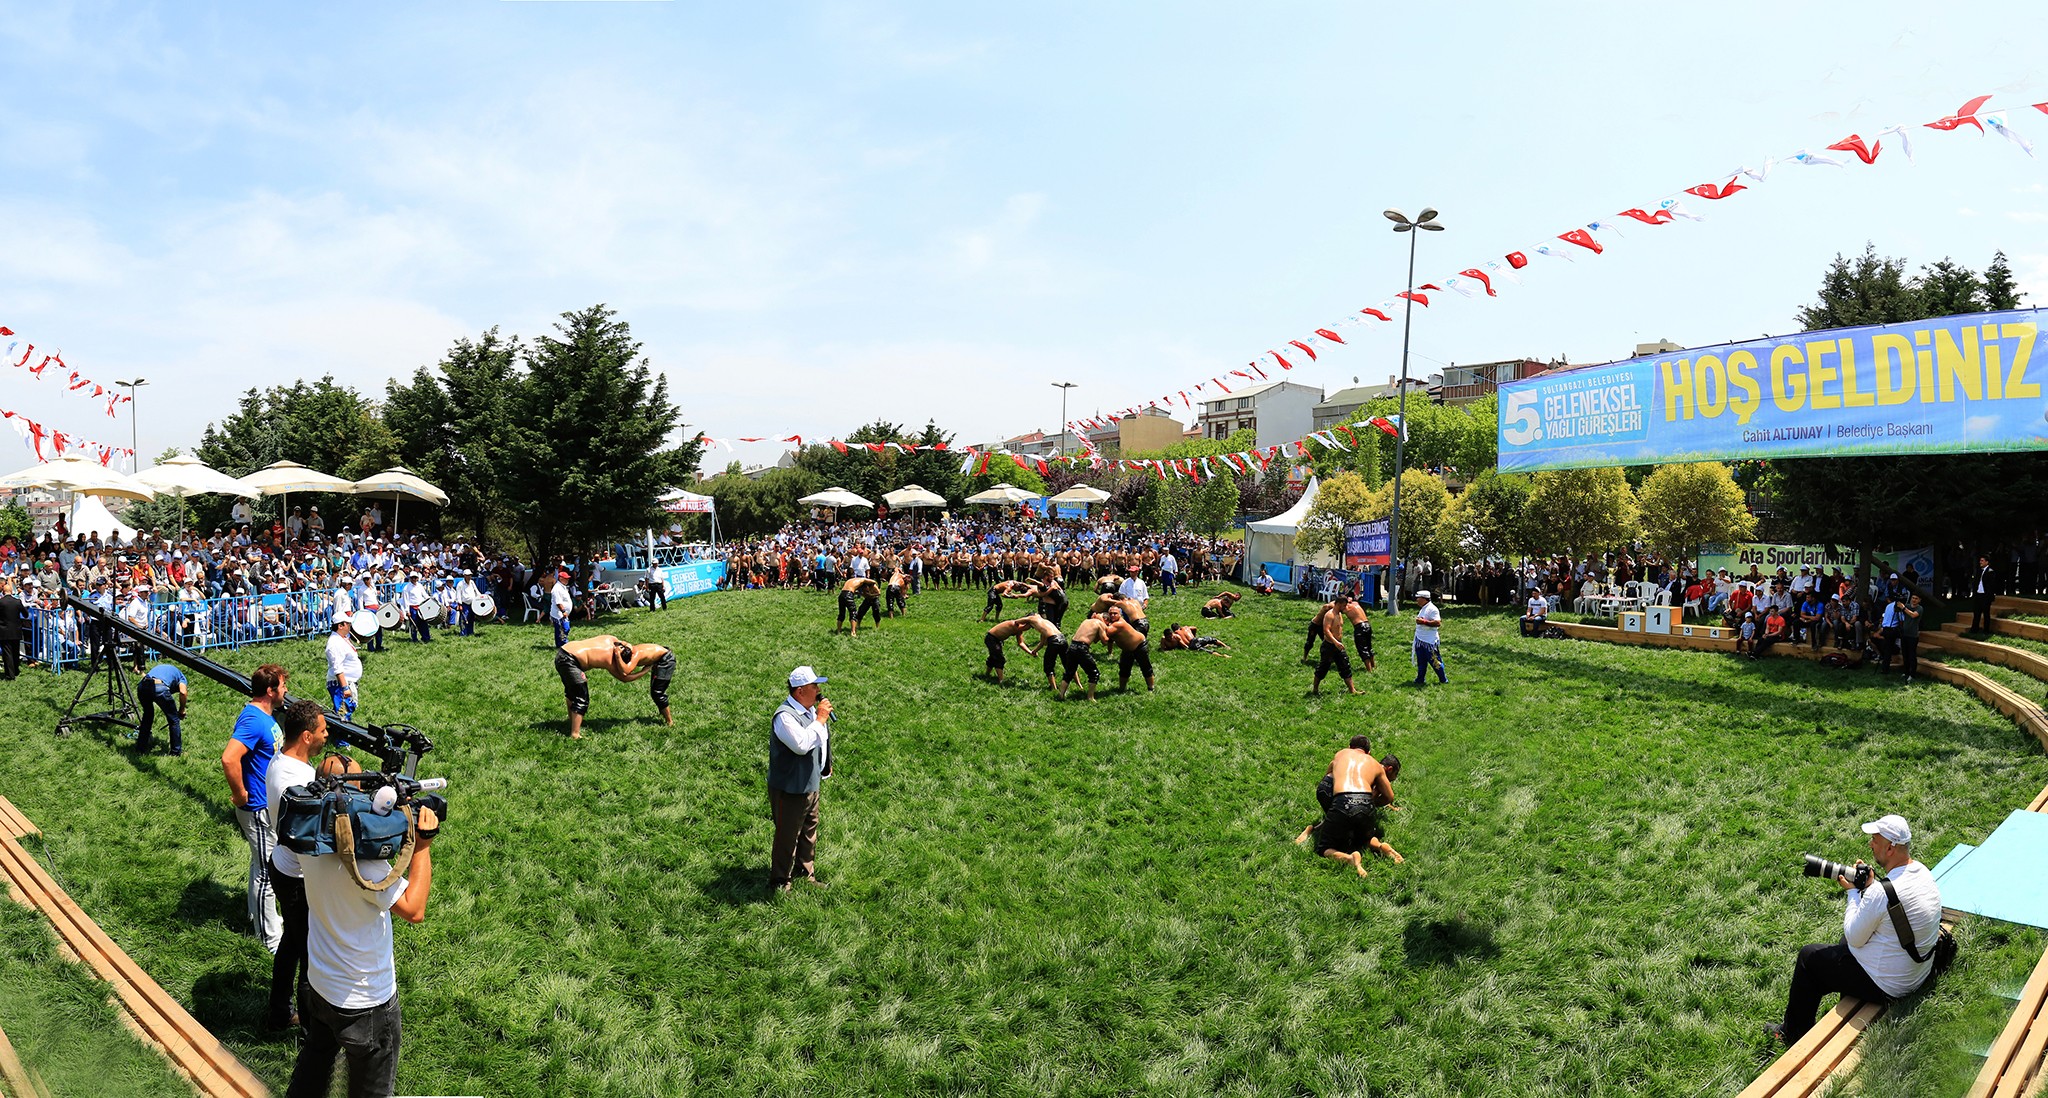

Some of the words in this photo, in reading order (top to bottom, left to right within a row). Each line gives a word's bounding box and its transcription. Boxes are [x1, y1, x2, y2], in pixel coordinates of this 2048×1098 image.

[1660, 350, 1761, 425] HOŞ
[1769, 322, 2041, 413] GELDİNİZ
[1544, 383, 1641, 422] GELENEKSEL
[1503, 389, 1543, 446] 5.
[1545, 418, 1576, 440] YAĞLI
[1578, 410, 1642, 437] GÜREŞLERİ
[1742, 428, 1771, 443] Cahit
[1772, 426, 1823, 441] ALTUNAY
[1837, 424, 1884, 440] Belediye
[1887, 422, 1933, 438] Başkanı
[1739, 548, 1764, 565] Ata
[1629, 618, 1636, 626] 2
[1653, 612, 1661, 626] 1
